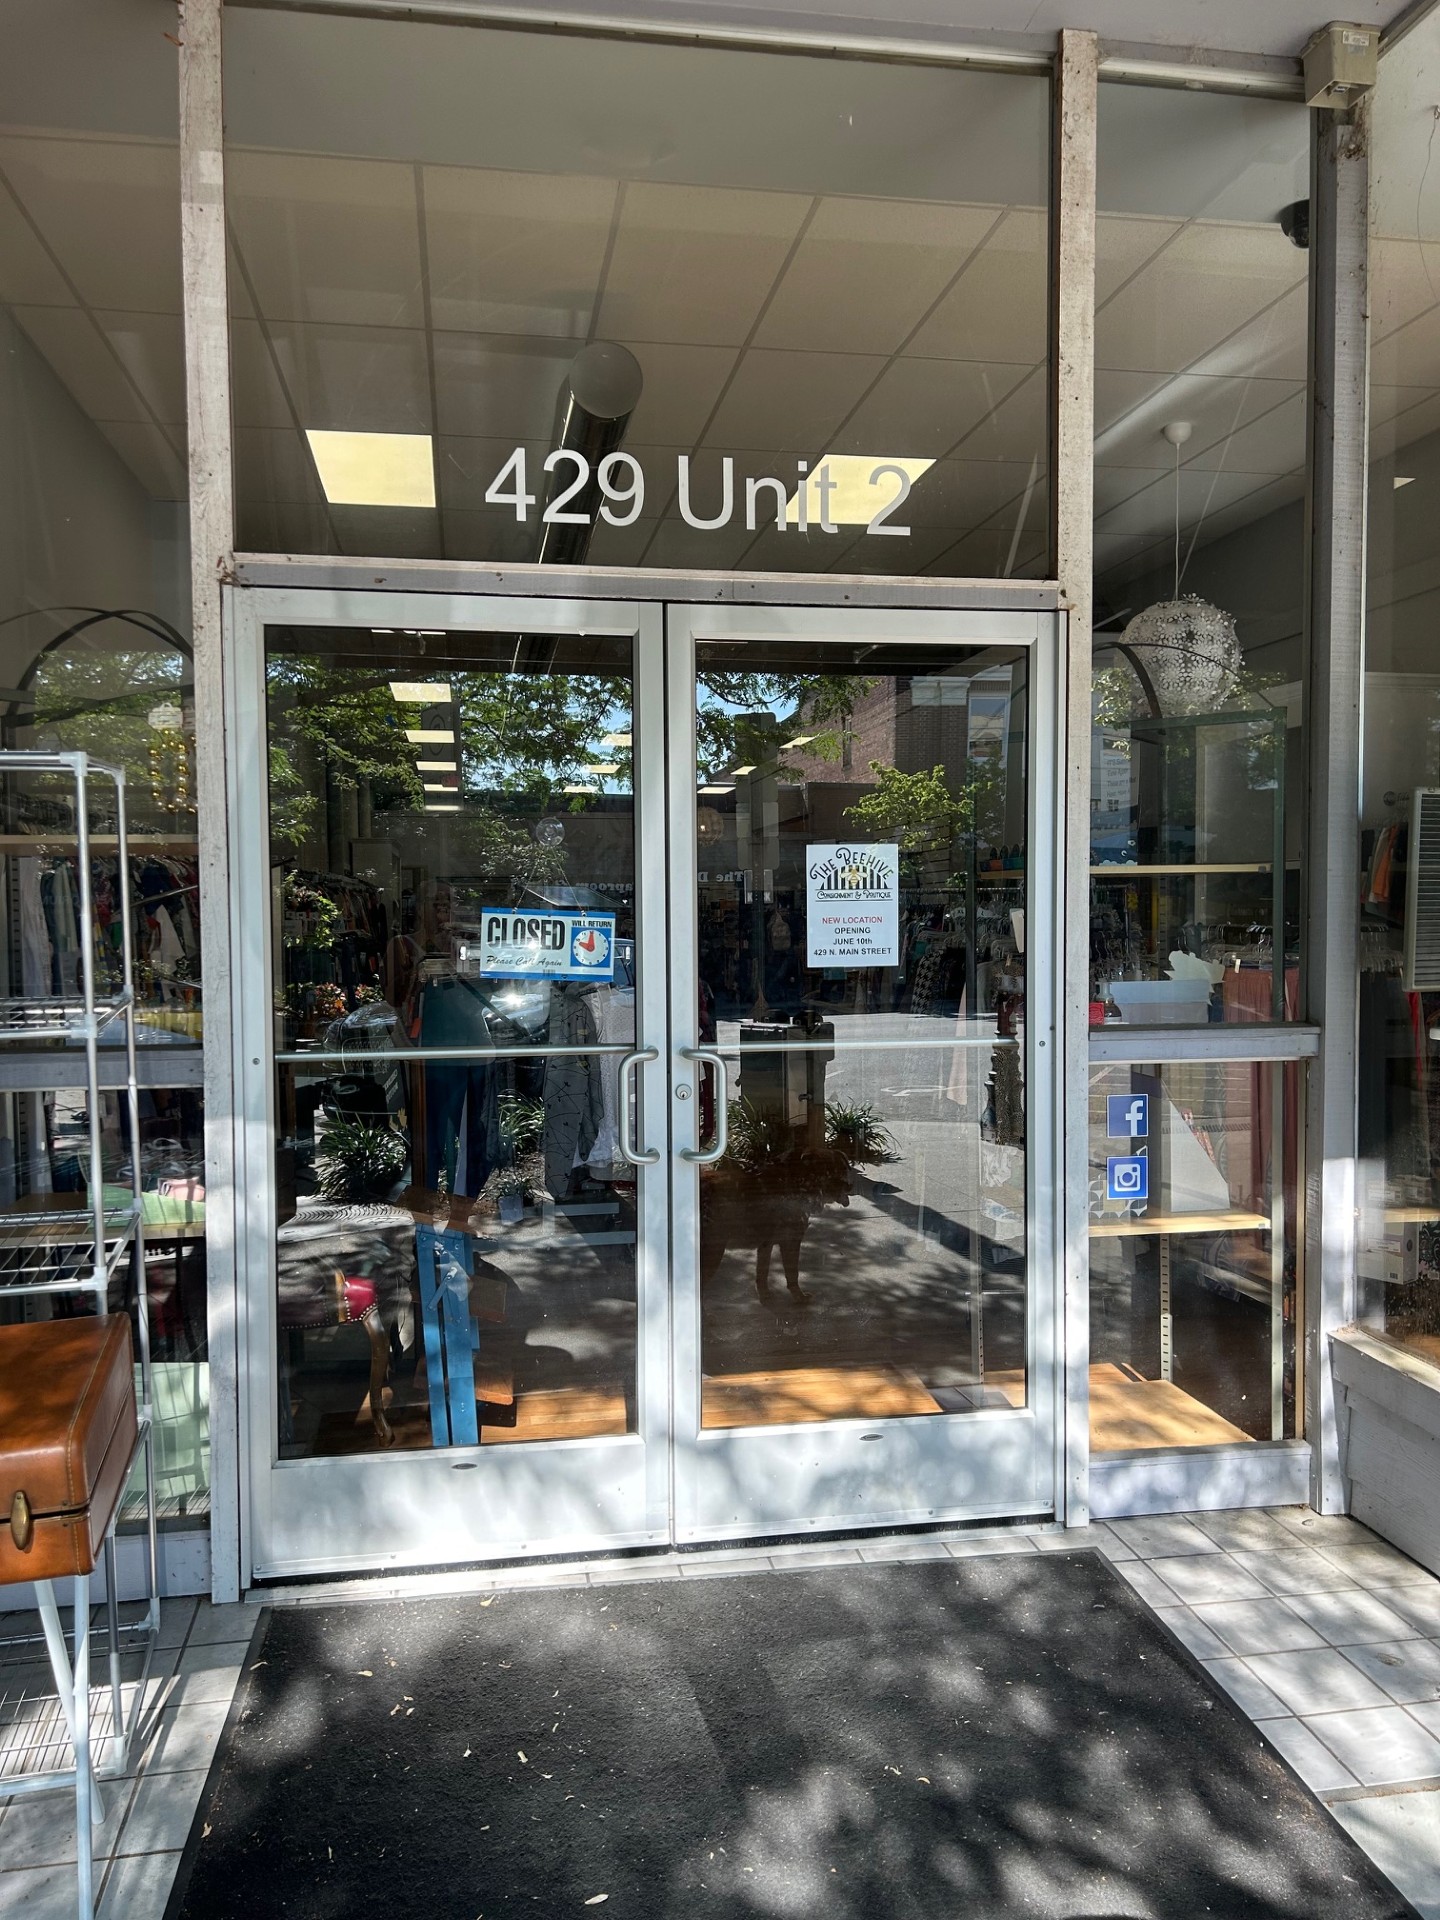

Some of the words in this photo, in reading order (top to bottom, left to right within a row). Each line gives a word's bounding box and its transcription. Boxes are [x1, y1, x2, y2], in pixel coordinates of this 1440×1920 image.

[485, 447, 645, 527] 429
[677, 454, 838, 534] Unit
[866, 465, 911, 536] 2
[810, 858, 838, 880] THE
[835, 847, 894, 880] BEEHIVE
[843, 916, 882, 924] LOCATION
[488, 917, 565, 950] CLOSED
[834, 927, 871, 935] OPENING
[856, 937, 872, 945] 10th
[861, 947, 892, 955] STREET
[486, 955, 512, 964] Please
[536, 957, 562, 968] Again
